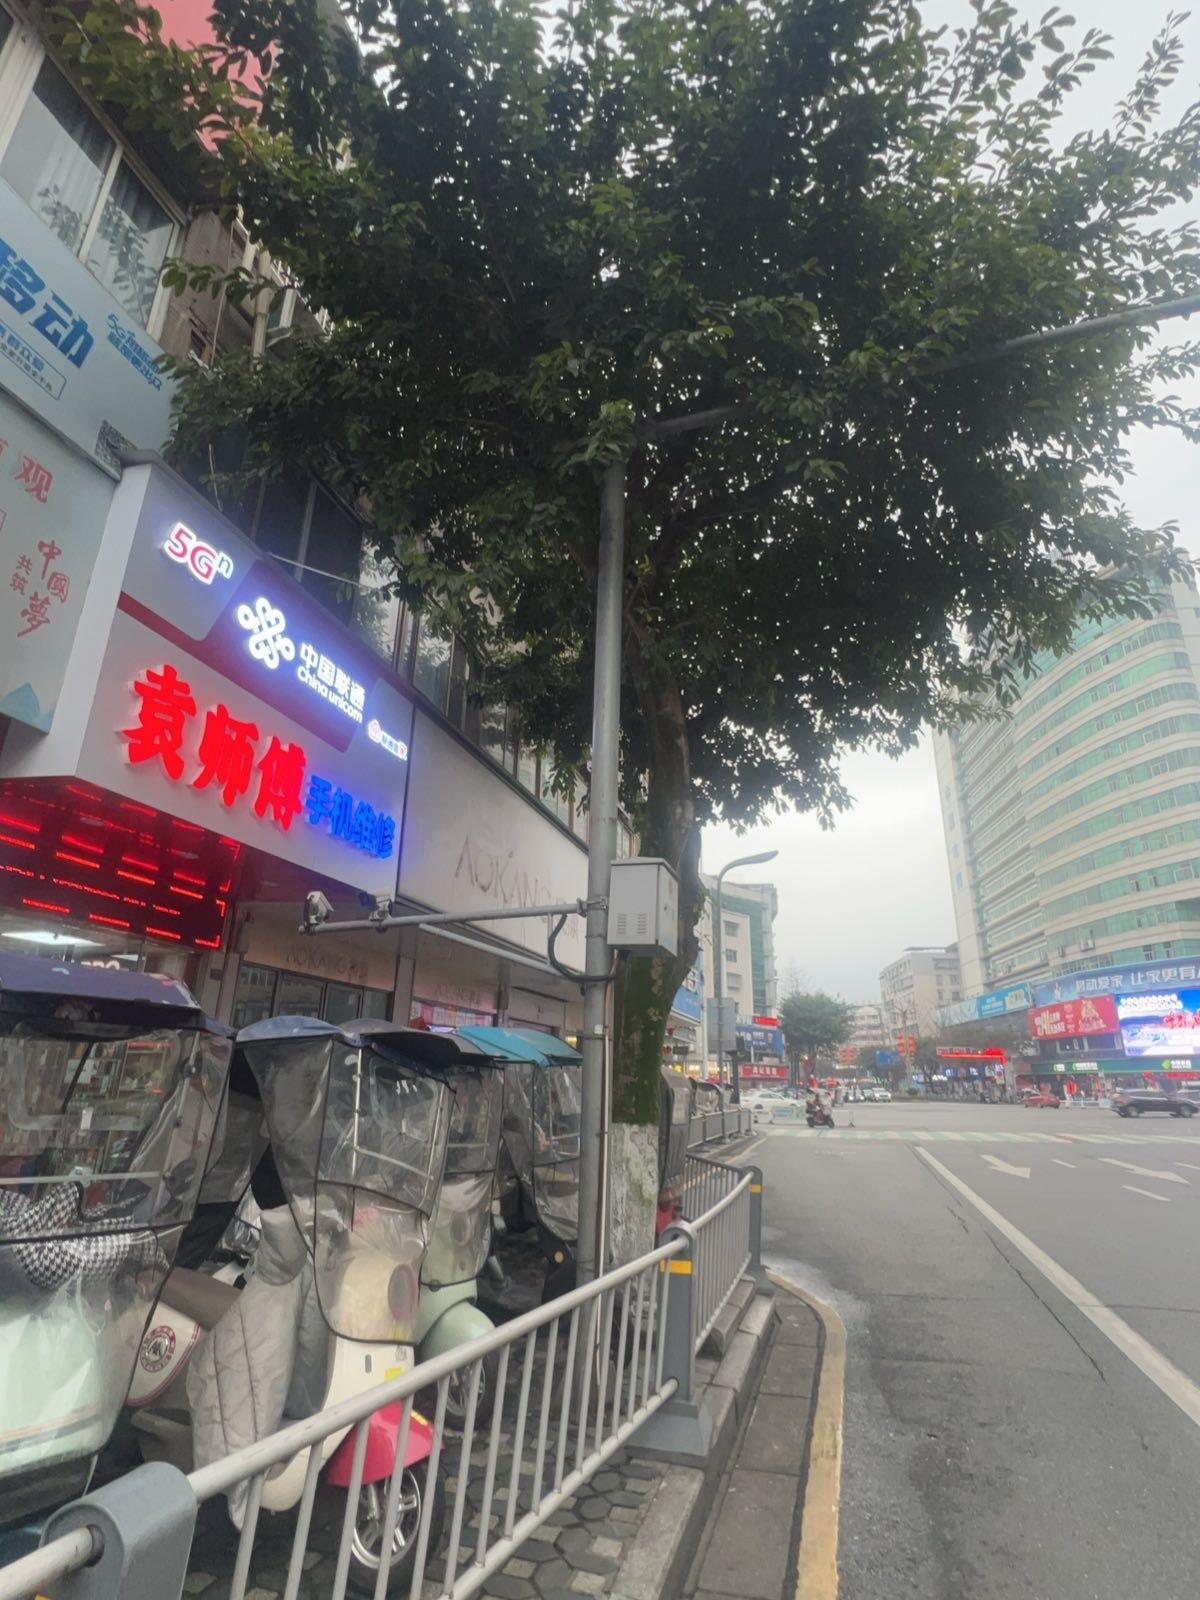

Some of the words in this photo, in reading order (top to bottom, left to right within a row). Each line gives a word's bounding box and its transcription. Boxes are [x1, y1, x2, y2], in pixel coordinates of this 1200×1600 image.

[299, 642, 366, 711] 中国联通
[122, 664, 307, 832] 袁师傅
[306, 773, 395, 859] 手机维修
[1130, 965, 1200, 986] 让家更有
